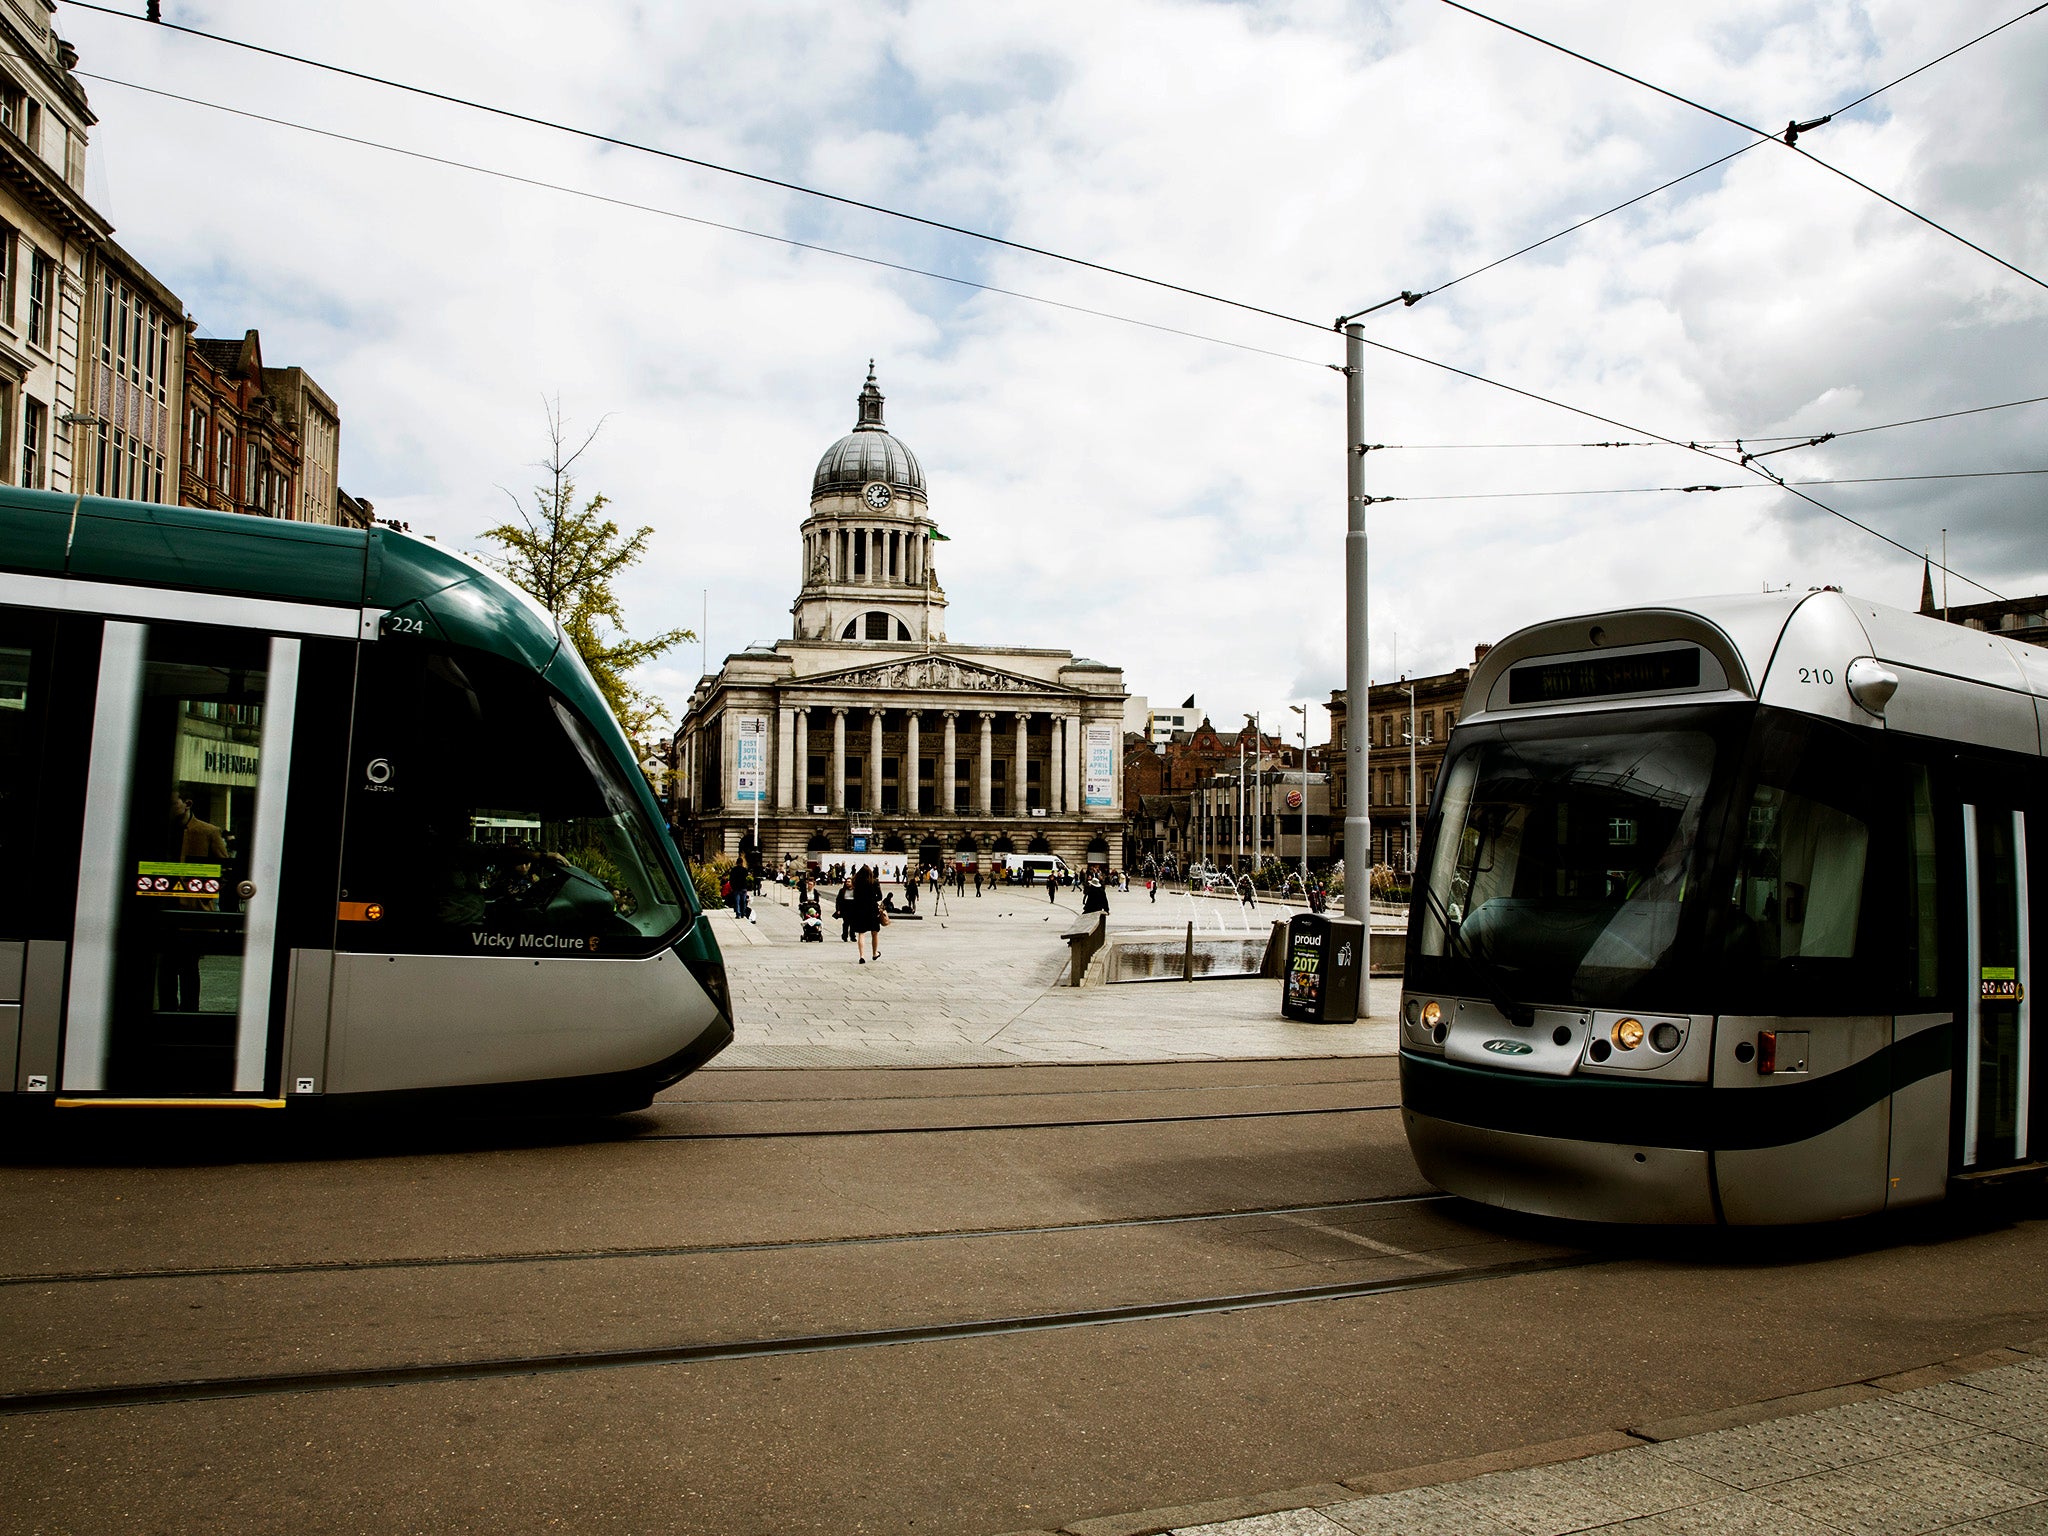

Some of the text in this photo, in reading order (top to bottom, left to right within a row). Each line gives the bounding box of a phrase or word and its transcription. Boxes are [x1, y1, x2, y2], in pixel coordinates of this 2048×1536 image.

[392, 616, 423, 634] 224
[1799, 667, 1834, 685] 210
[364, 784, 394, 793] ALSTOM
[472, 932, 584, 949] Vicky McClure
[1294, 935, 1321, 946] proud
[1293, 956, 1319, 972] 2017
[1489, 1041, 1528, 1053] NET
